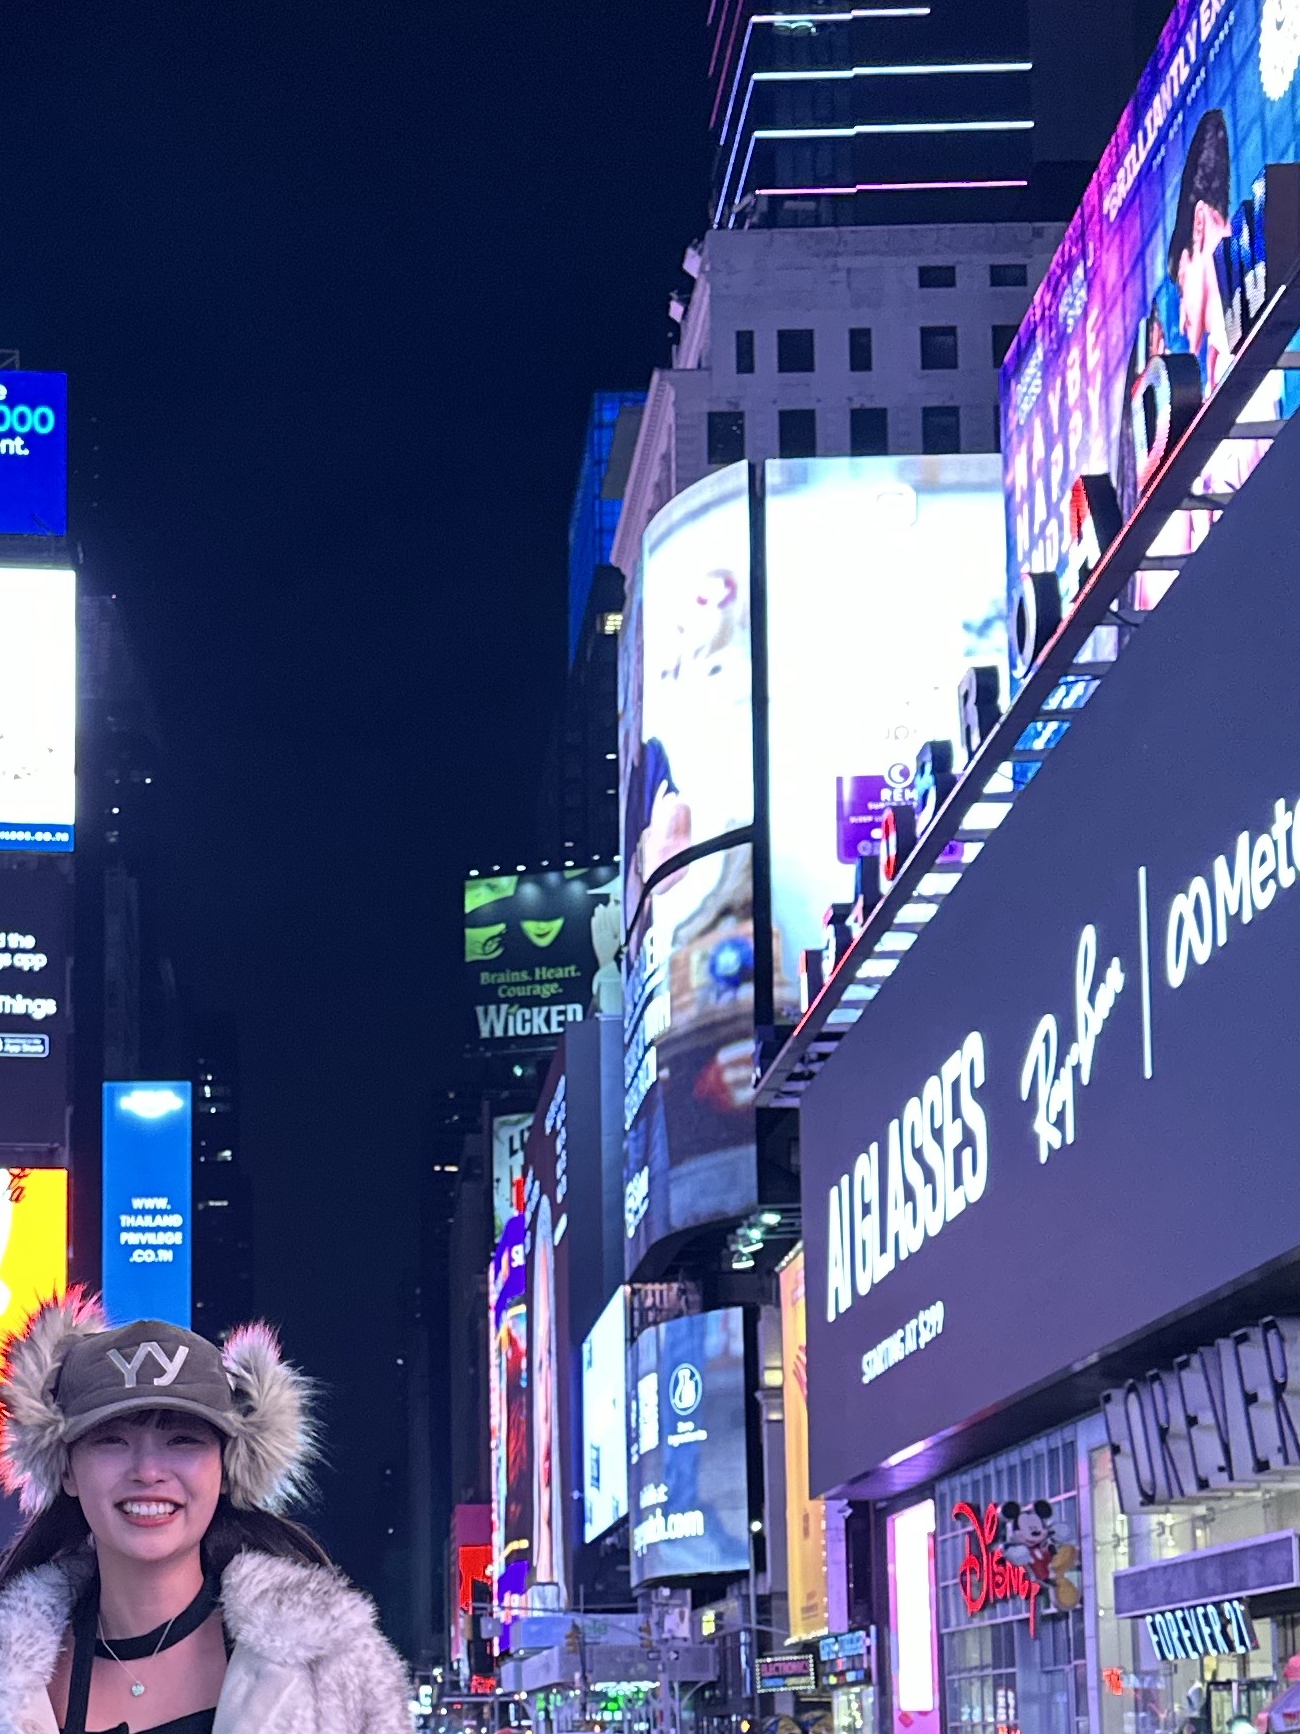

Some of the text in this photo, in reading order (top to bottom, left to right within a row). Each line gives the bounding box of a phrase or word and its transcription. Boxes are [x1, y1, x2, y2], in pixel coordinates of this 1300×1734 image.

[7, 932, 36, 950] the
[13, 953, 48, 972] app
[480, 964, 582, 986] Brains. Heart.
[497, 981, 564, 999] Courage.
[853, 1030, 988, 1298] GLASSES
[130, 1196, 172, 1210] WWW.
[119, 1214, 184, 1228] THAILAND
[119, 1231, 183, 1245] PRIVILEGE
[128, 1248, 174, 1264] .CO.TH
[1102, 1315, 1300, 1515] FOREVER
[1145, 1599, 1251, 1662] FOREVER 21
